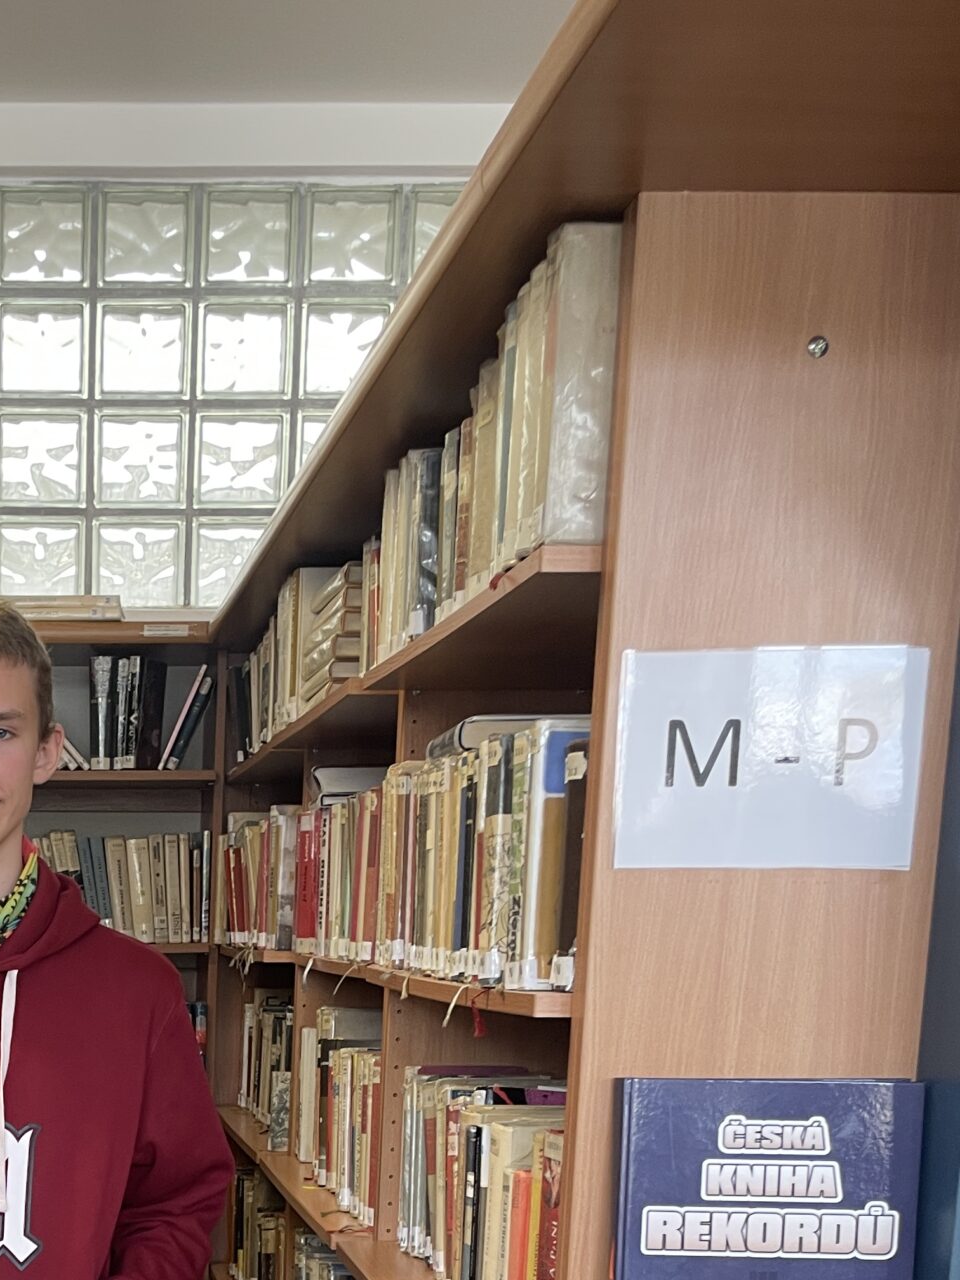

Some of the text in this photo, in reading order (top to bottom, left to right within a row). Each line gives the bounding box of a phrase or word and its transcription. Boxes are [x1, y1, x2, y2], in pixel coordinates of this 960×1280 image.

[664, 718, 742, 788] M
[833, 717, 879, 786] P
[722, 1117, 826, 1152] ČESKÁ
[705, 1162, 838, 1199] KNIHA
[645, 1206, 895, 1256] REKORDŮ
